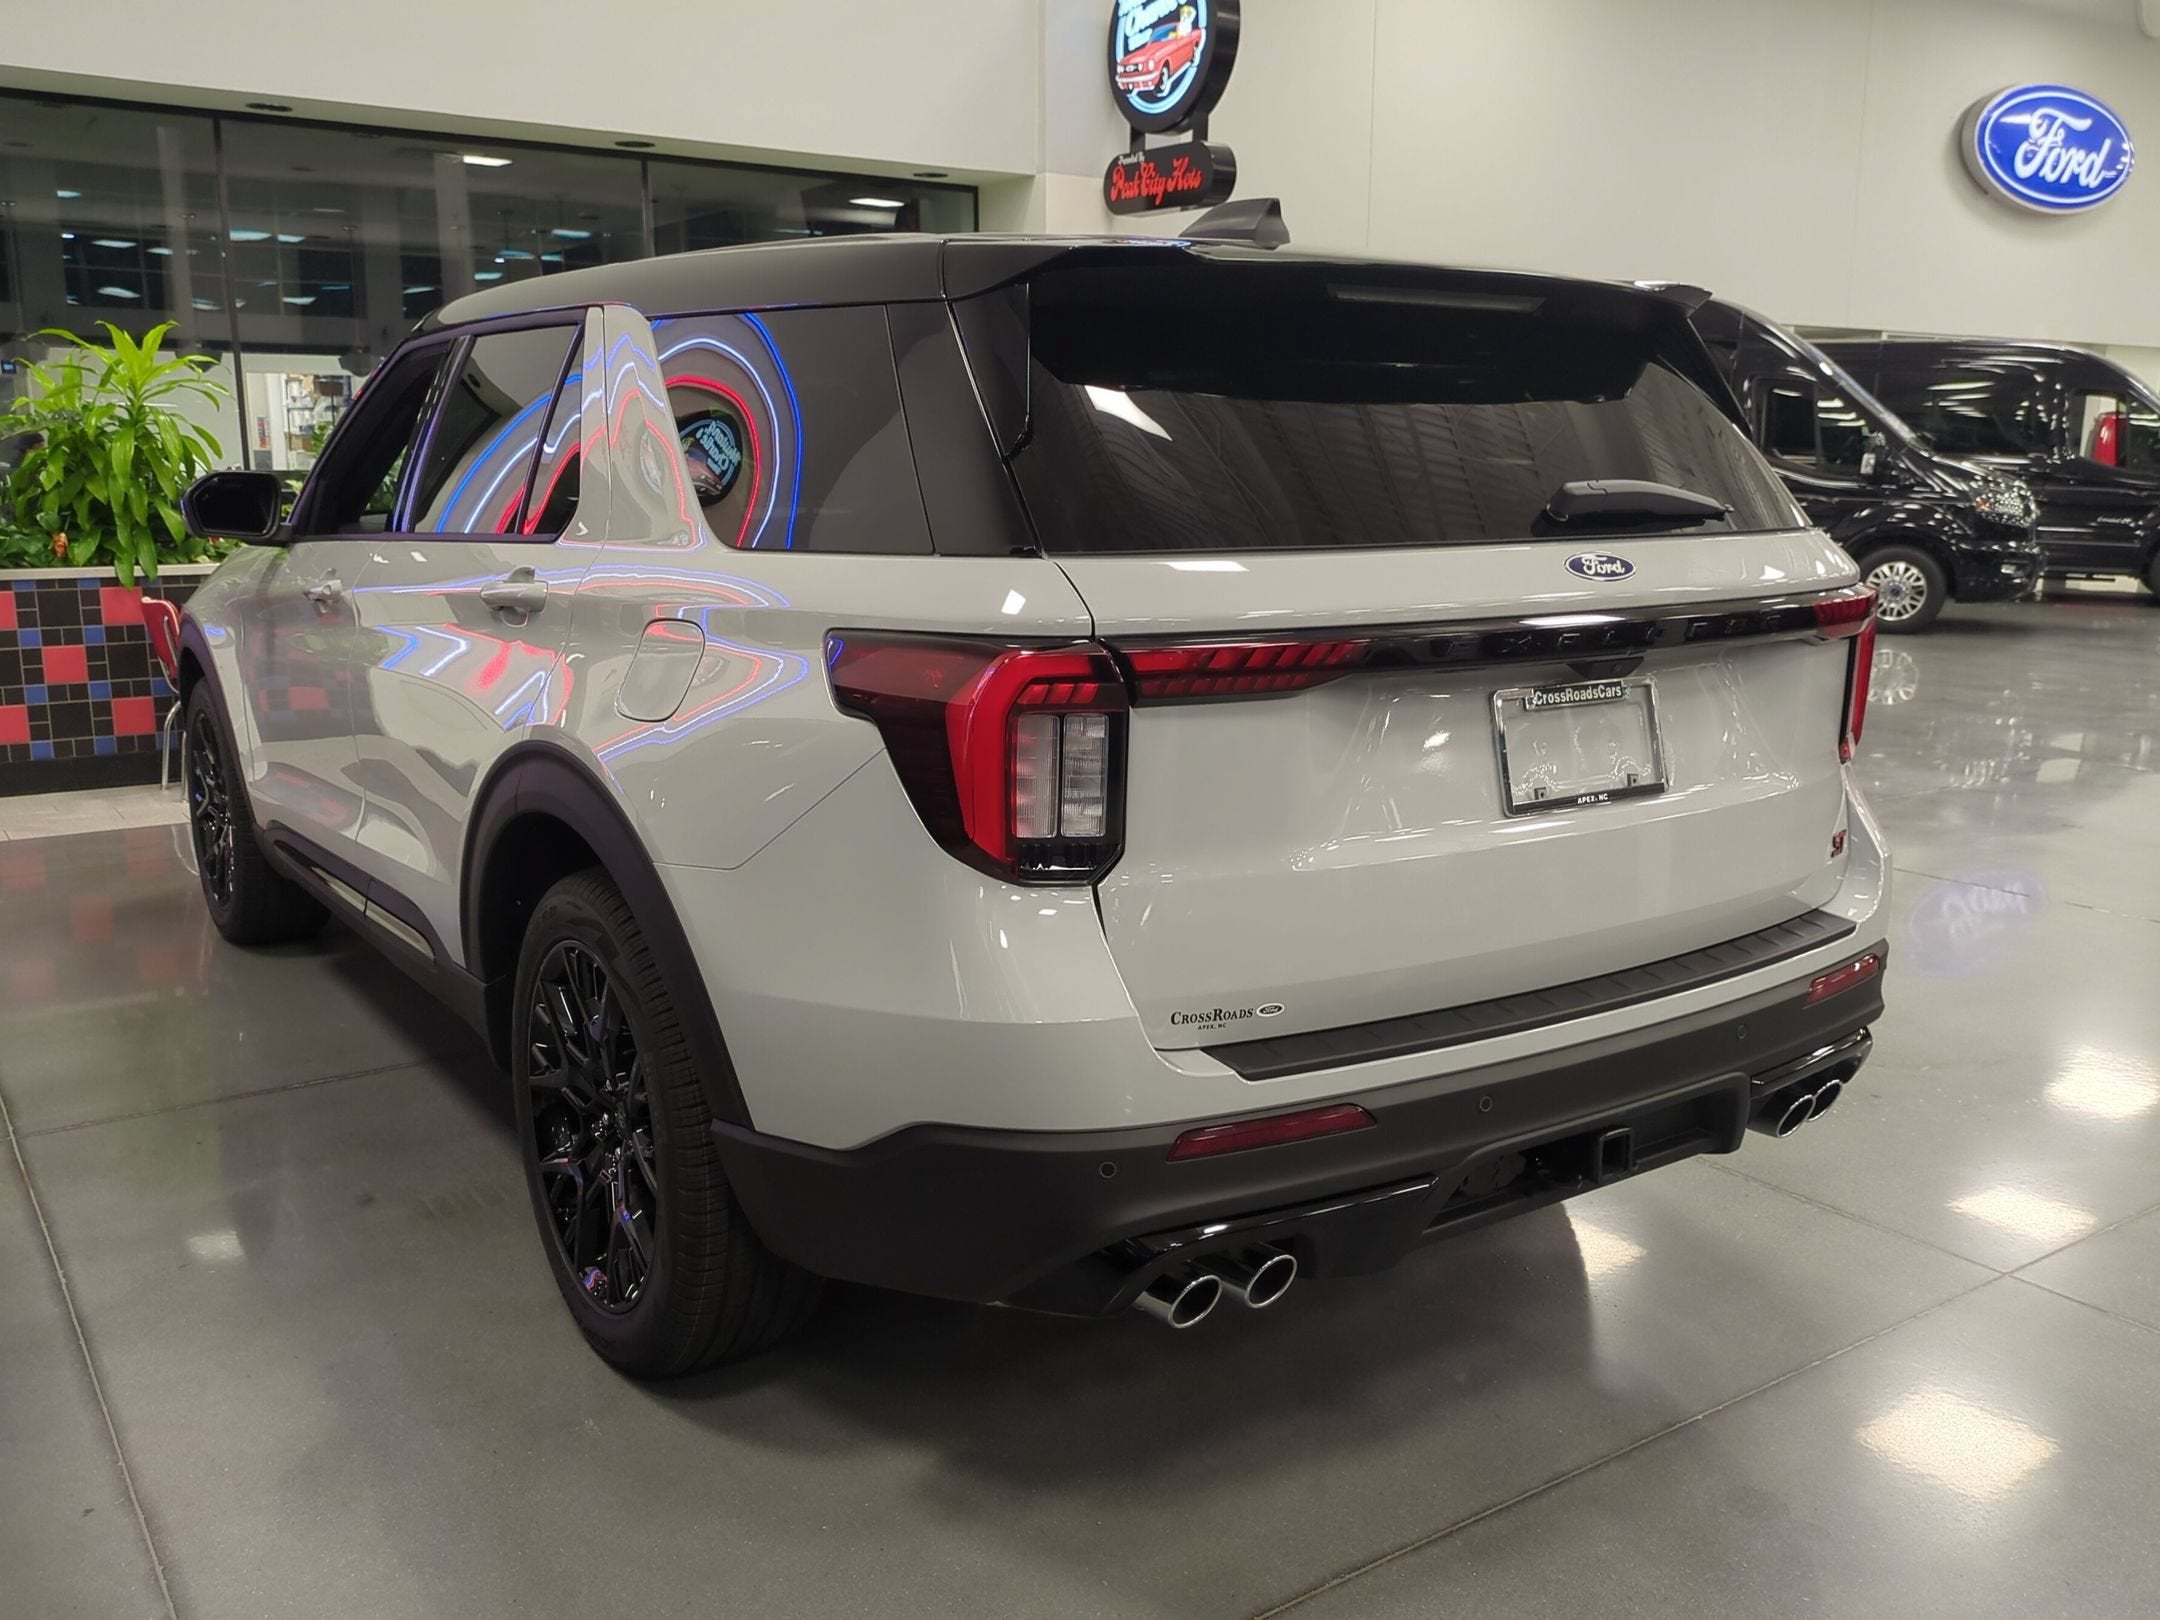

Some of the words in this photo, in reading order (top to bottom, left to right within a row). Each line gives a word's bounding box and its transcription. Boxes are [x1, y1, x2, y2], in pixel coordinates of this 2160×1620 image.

[2011, 107, 2117, 188] Ford
[1139, 161, 1166, 205] City
[1580, 554, 1626, 576] Ford
[1534, 683, 1623, 706] CrossRoadsCars
[1598, 793, 1609, 801] NC
